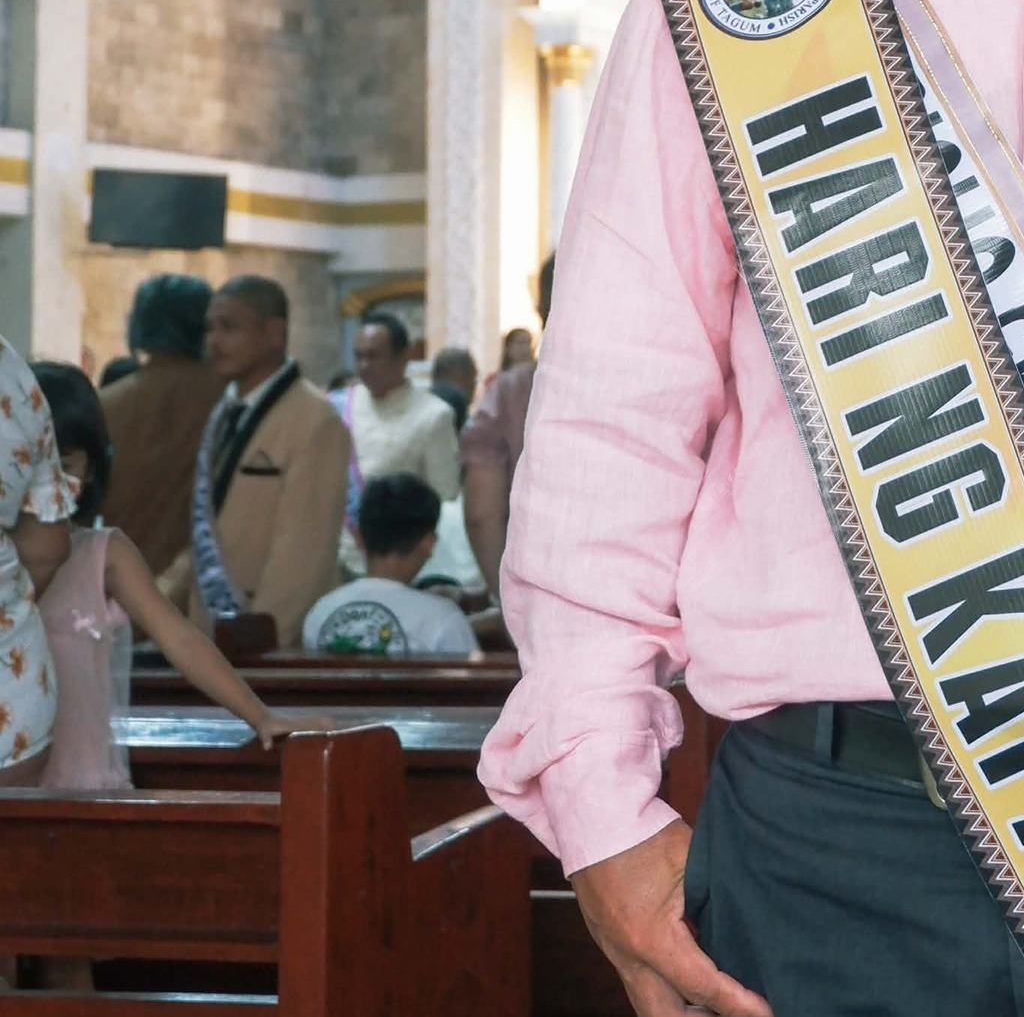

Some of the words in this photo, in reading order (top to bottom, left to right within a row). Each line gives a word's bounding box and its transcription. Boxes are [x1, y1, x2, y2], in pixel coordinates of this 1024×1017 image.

[718, 8, 762, 33] TAGUM
[745, 75, 949, 368] HARI
[844, 363, 1006, 543] NG
